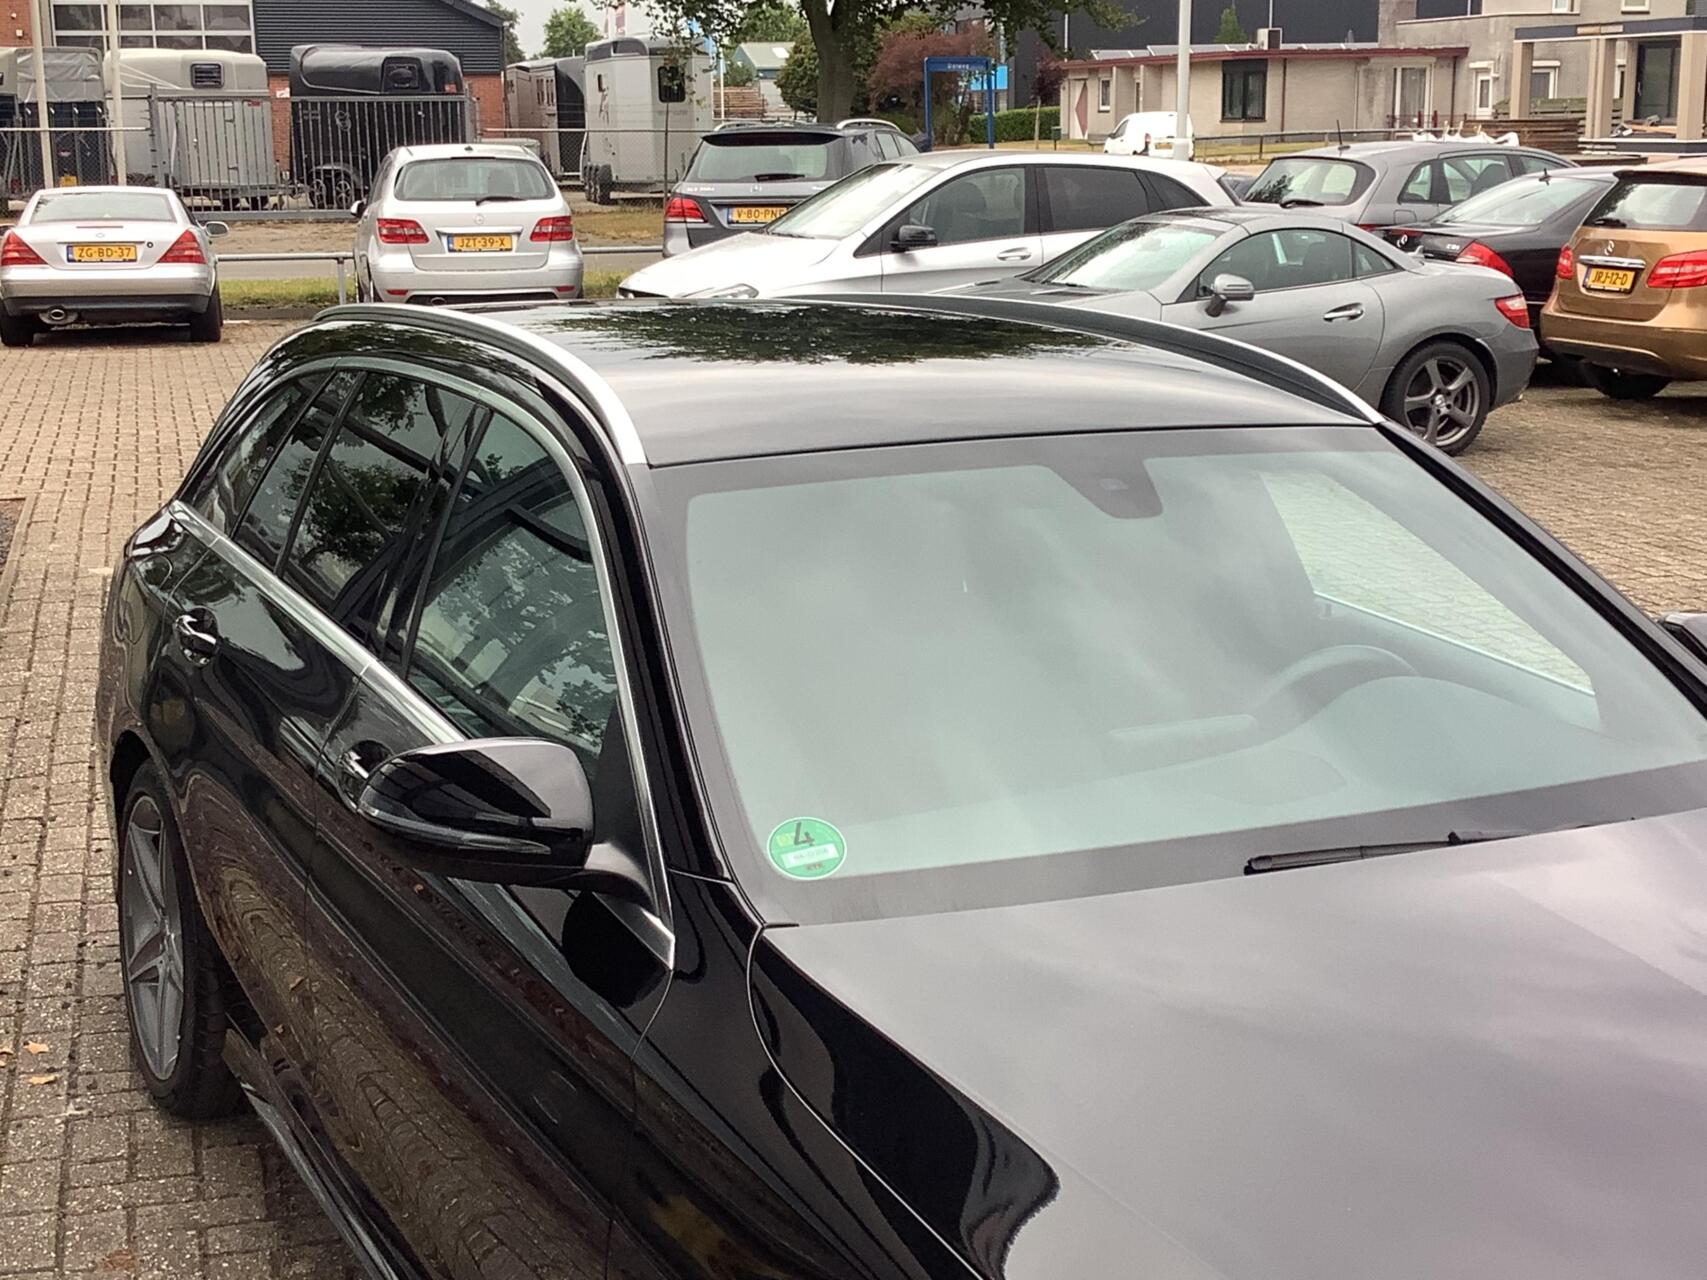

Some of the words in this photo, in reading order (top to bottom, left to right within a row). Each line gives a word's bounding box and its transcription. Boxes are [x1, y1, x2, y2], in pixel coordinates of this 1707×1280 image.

[459, 237, 506, 248] JZT-39-X
[78, 247, 132, 258] ZG-BD-37
[794, 821, 815, 846] 4
